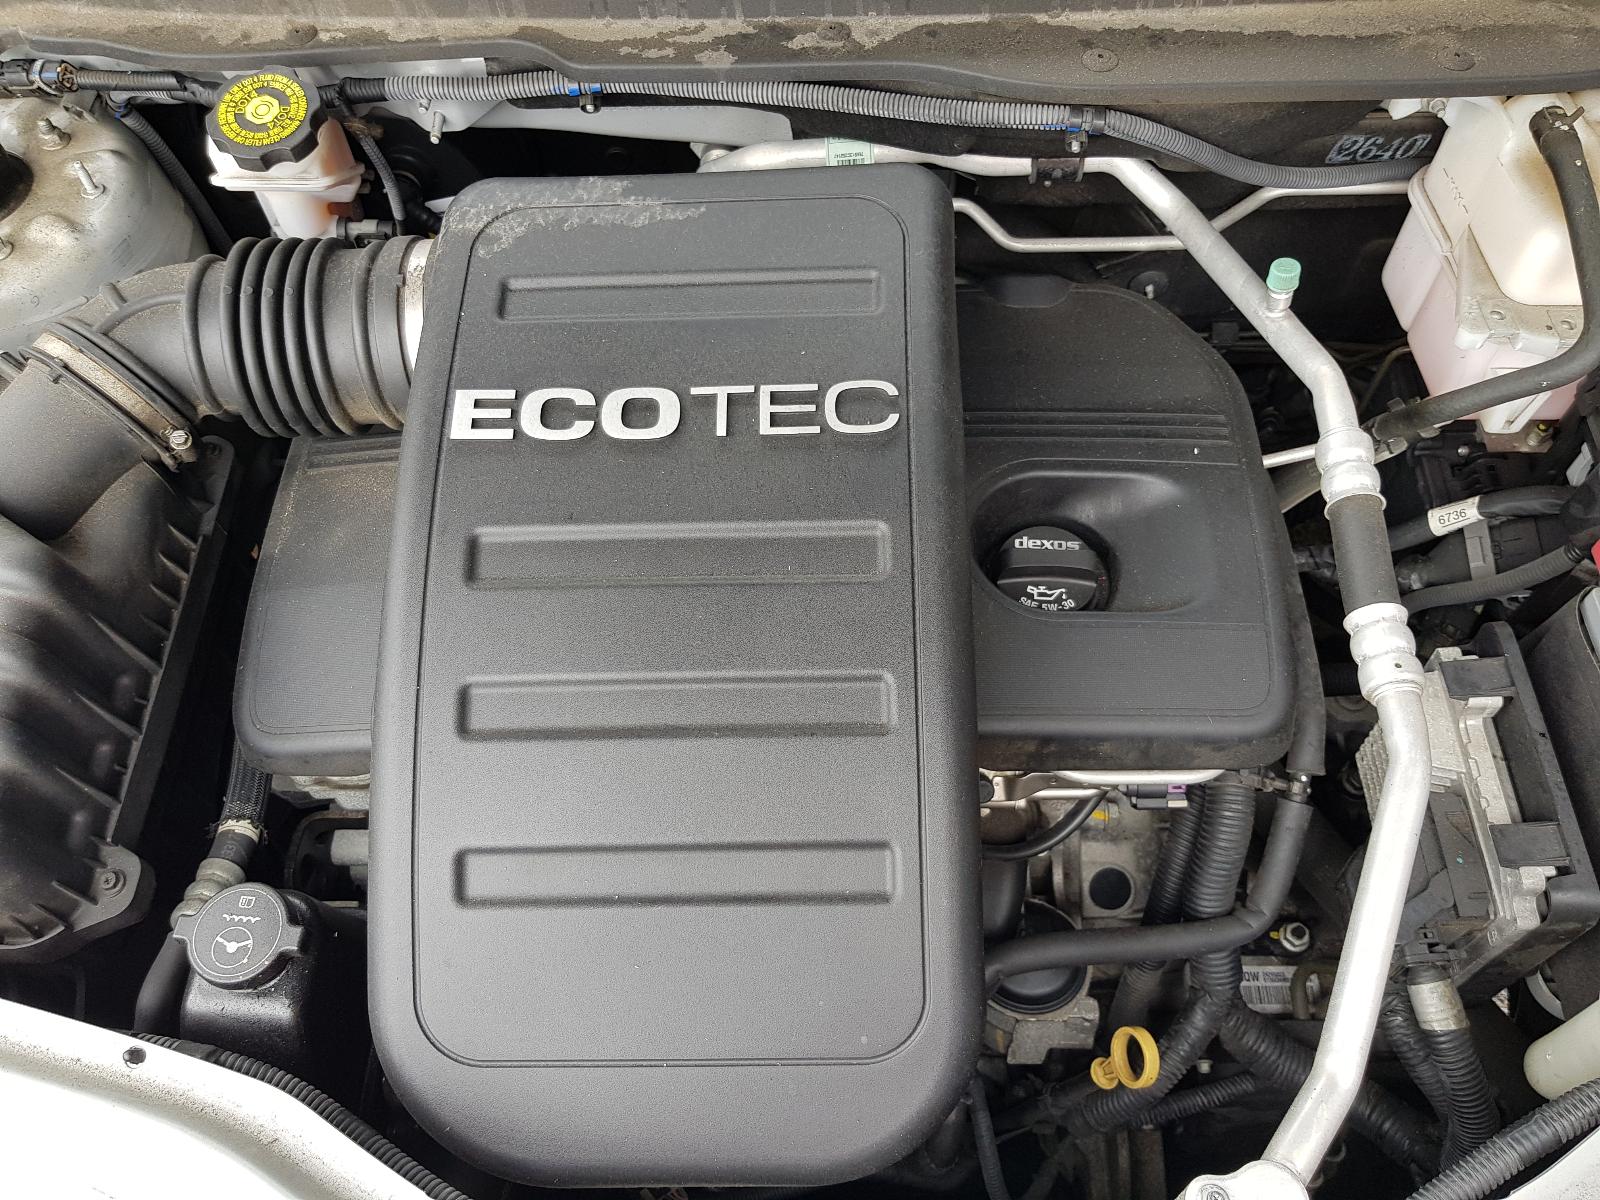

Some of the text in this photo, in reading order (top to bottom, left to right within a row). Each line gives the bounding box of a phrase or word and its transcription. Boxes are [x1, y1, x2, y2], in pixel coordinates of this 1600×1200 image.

[241, 77, 253, 86] DOT
[273, 74, 290, 84] FROM
[229, 82, 244, 94] ONLY
[222, 92, 234, 102] USE
[235, 94, 251, 114] DOT
[250, 90, 258, 98] 4
[274, 106, 290, 126] DOT
[220, 123, 237, 139] BEFORE
[267, 121, 275, 129] 4
[233, 135, 245, 144] CAP
[243, 138, 261, 146] FILLER
[263, 134, 281, 145] CLEAN
[450, 379, 900, 441] ECOTEC
[1438, 508, 1467, 525] 6736
[1014, 536, 1081, 551] dexos
[1041, 599, 1075, 611] 5W-30
